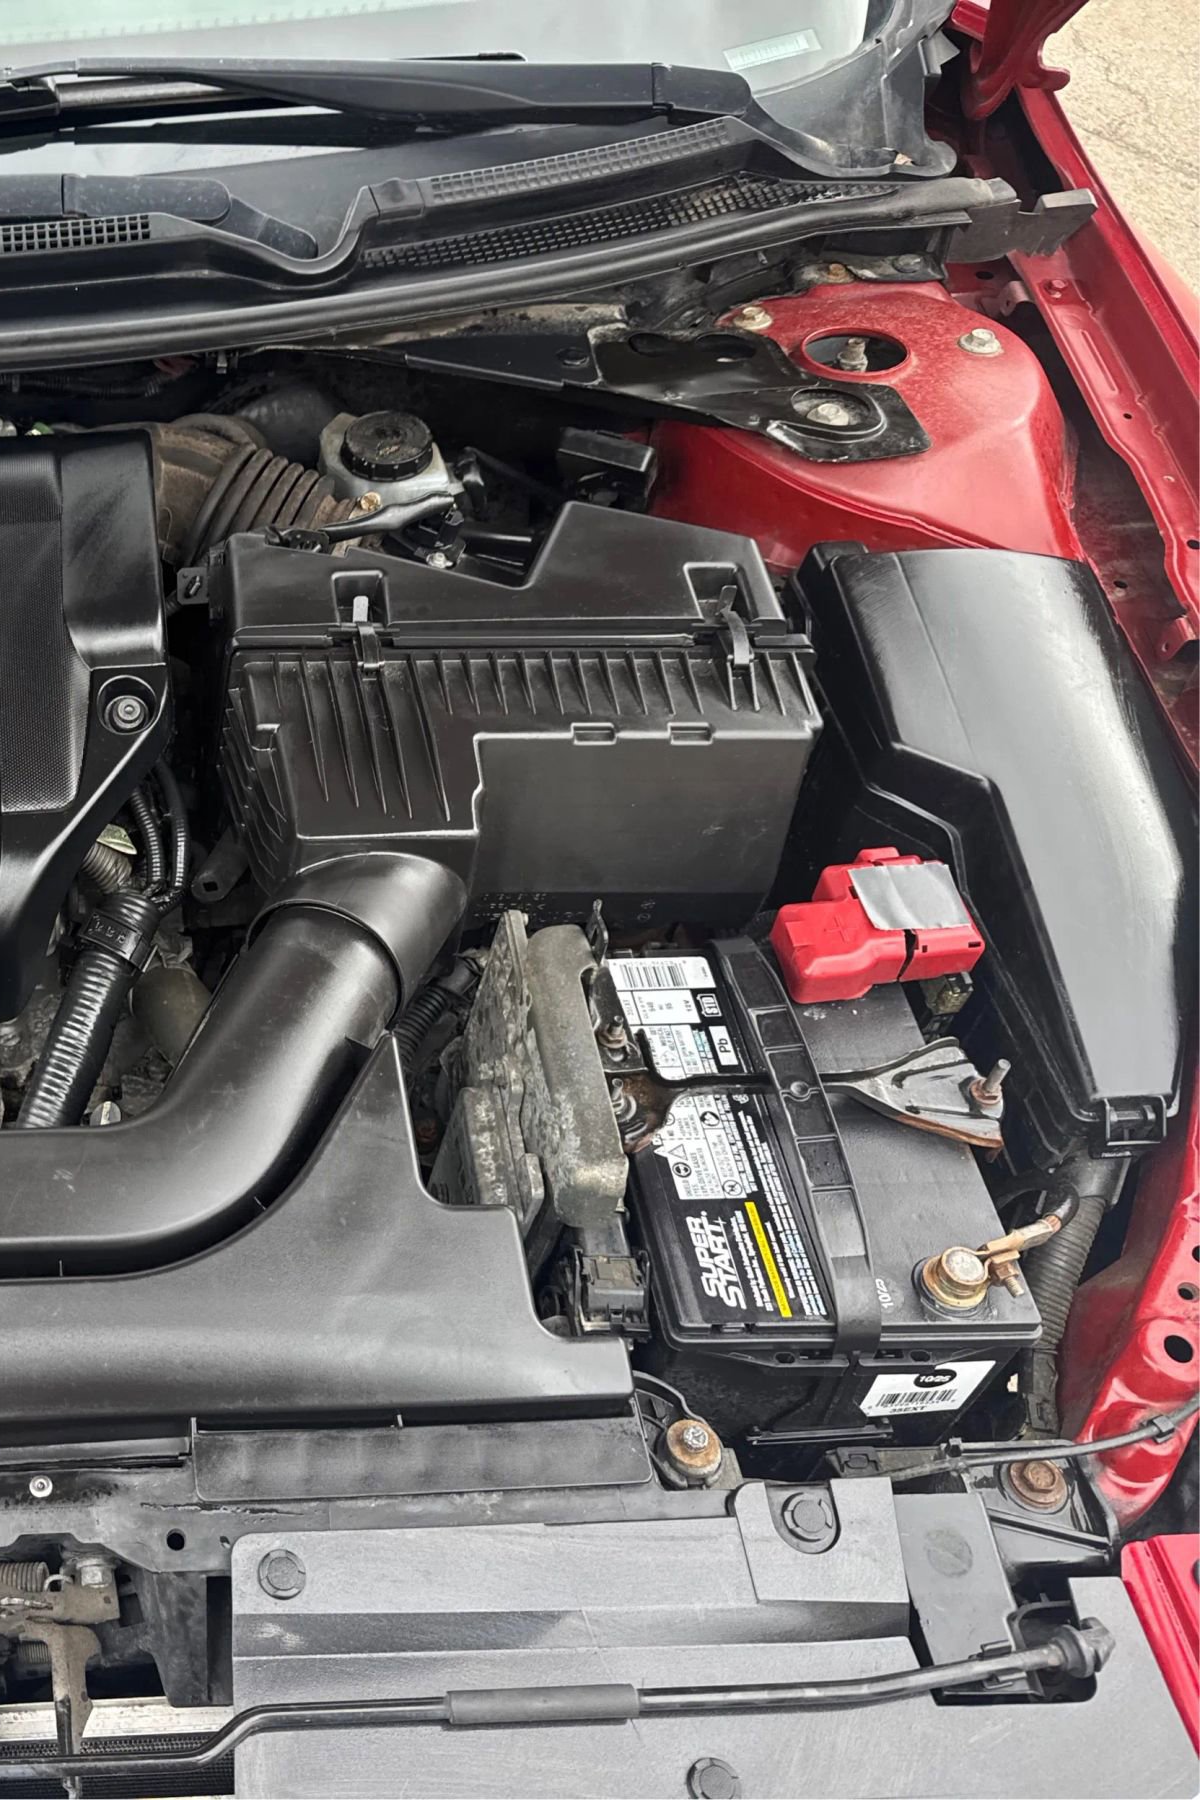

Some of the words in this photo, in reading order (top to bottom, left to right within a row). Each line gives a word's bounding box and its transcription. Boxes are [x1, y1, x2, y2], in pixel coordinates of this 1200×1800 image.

[717, 1038, 731, 1053] Pb
[686, 1216, 719, 1297] SUPER
[701, 1216, 747, 1310] START
